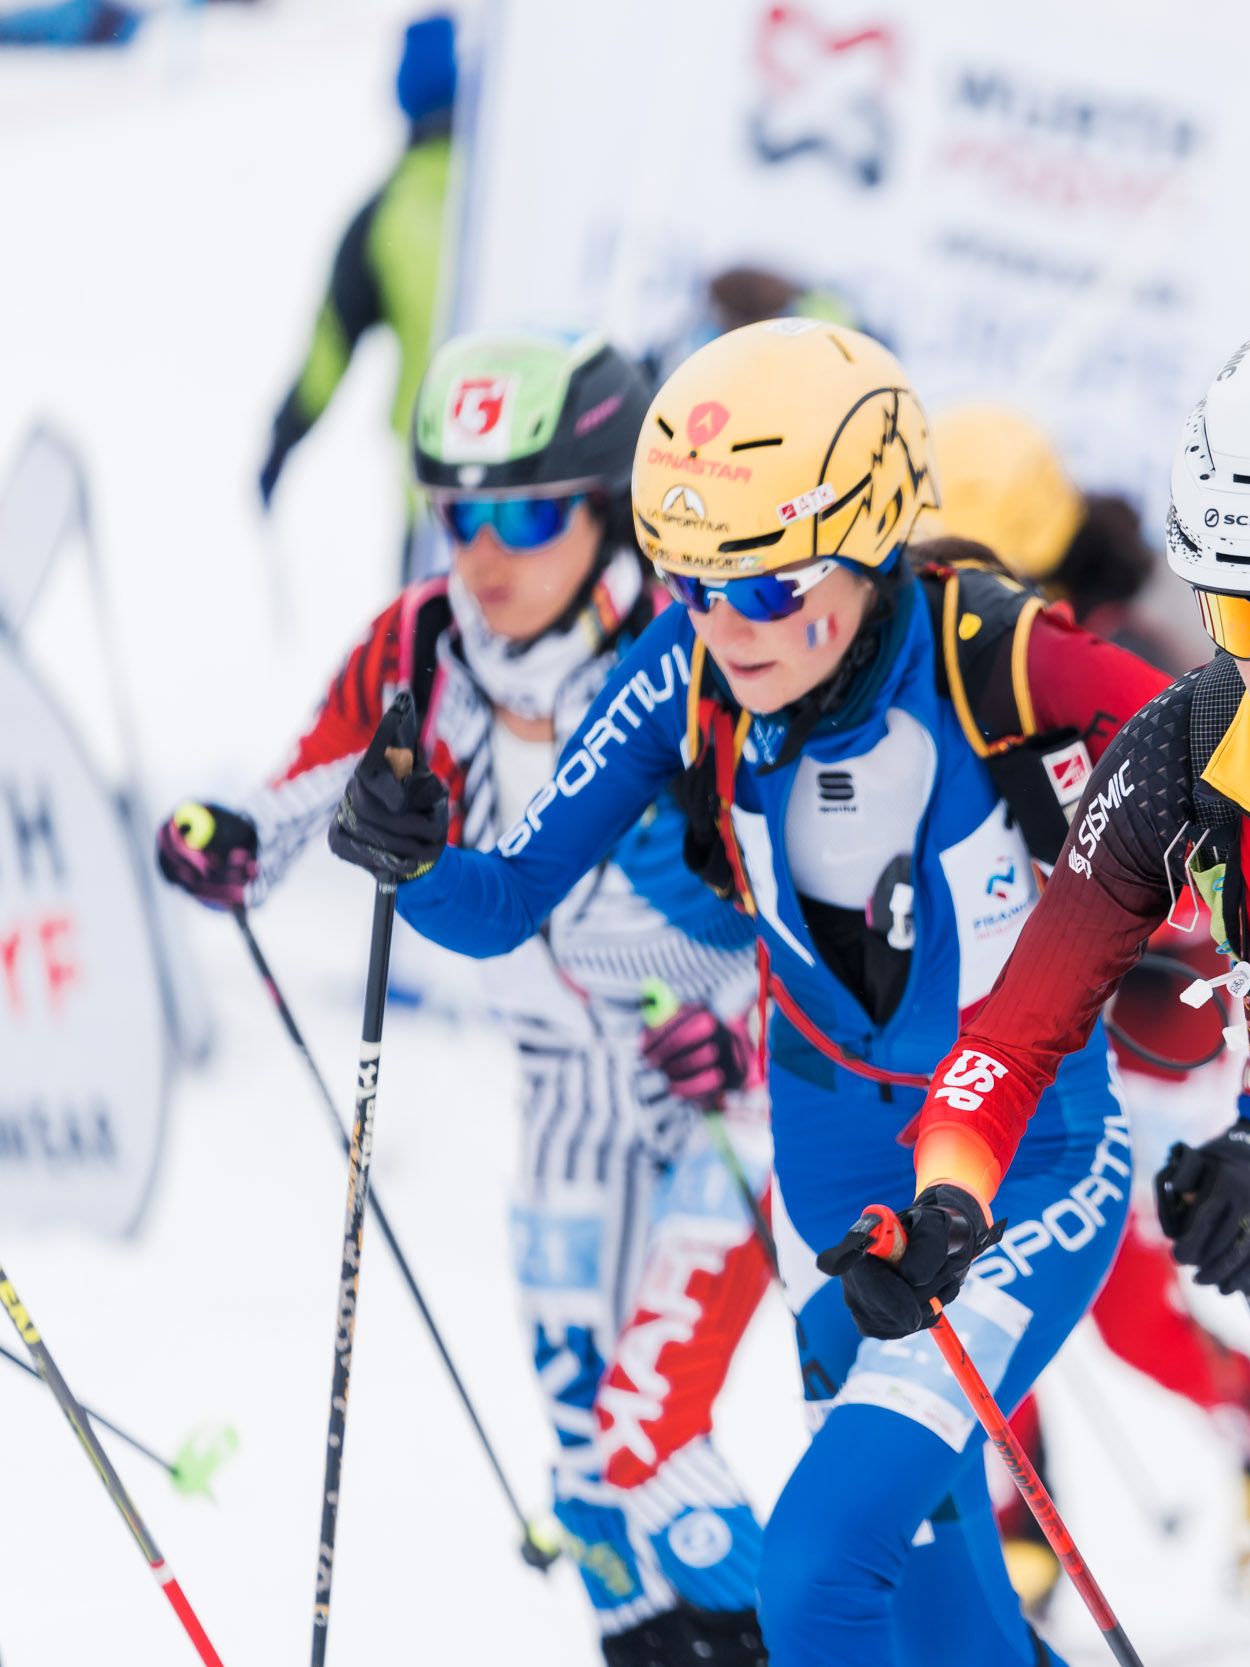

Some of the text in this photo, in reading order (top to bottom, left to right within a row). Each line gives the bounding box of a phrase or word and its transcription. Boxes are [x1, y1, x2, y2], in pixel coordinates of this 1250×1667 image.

[647, 447, 754, 483] DYNASTAR
[1078, 758, 1135, 859] SISMIC
[934, 1050, 1009, 1112] ESP
